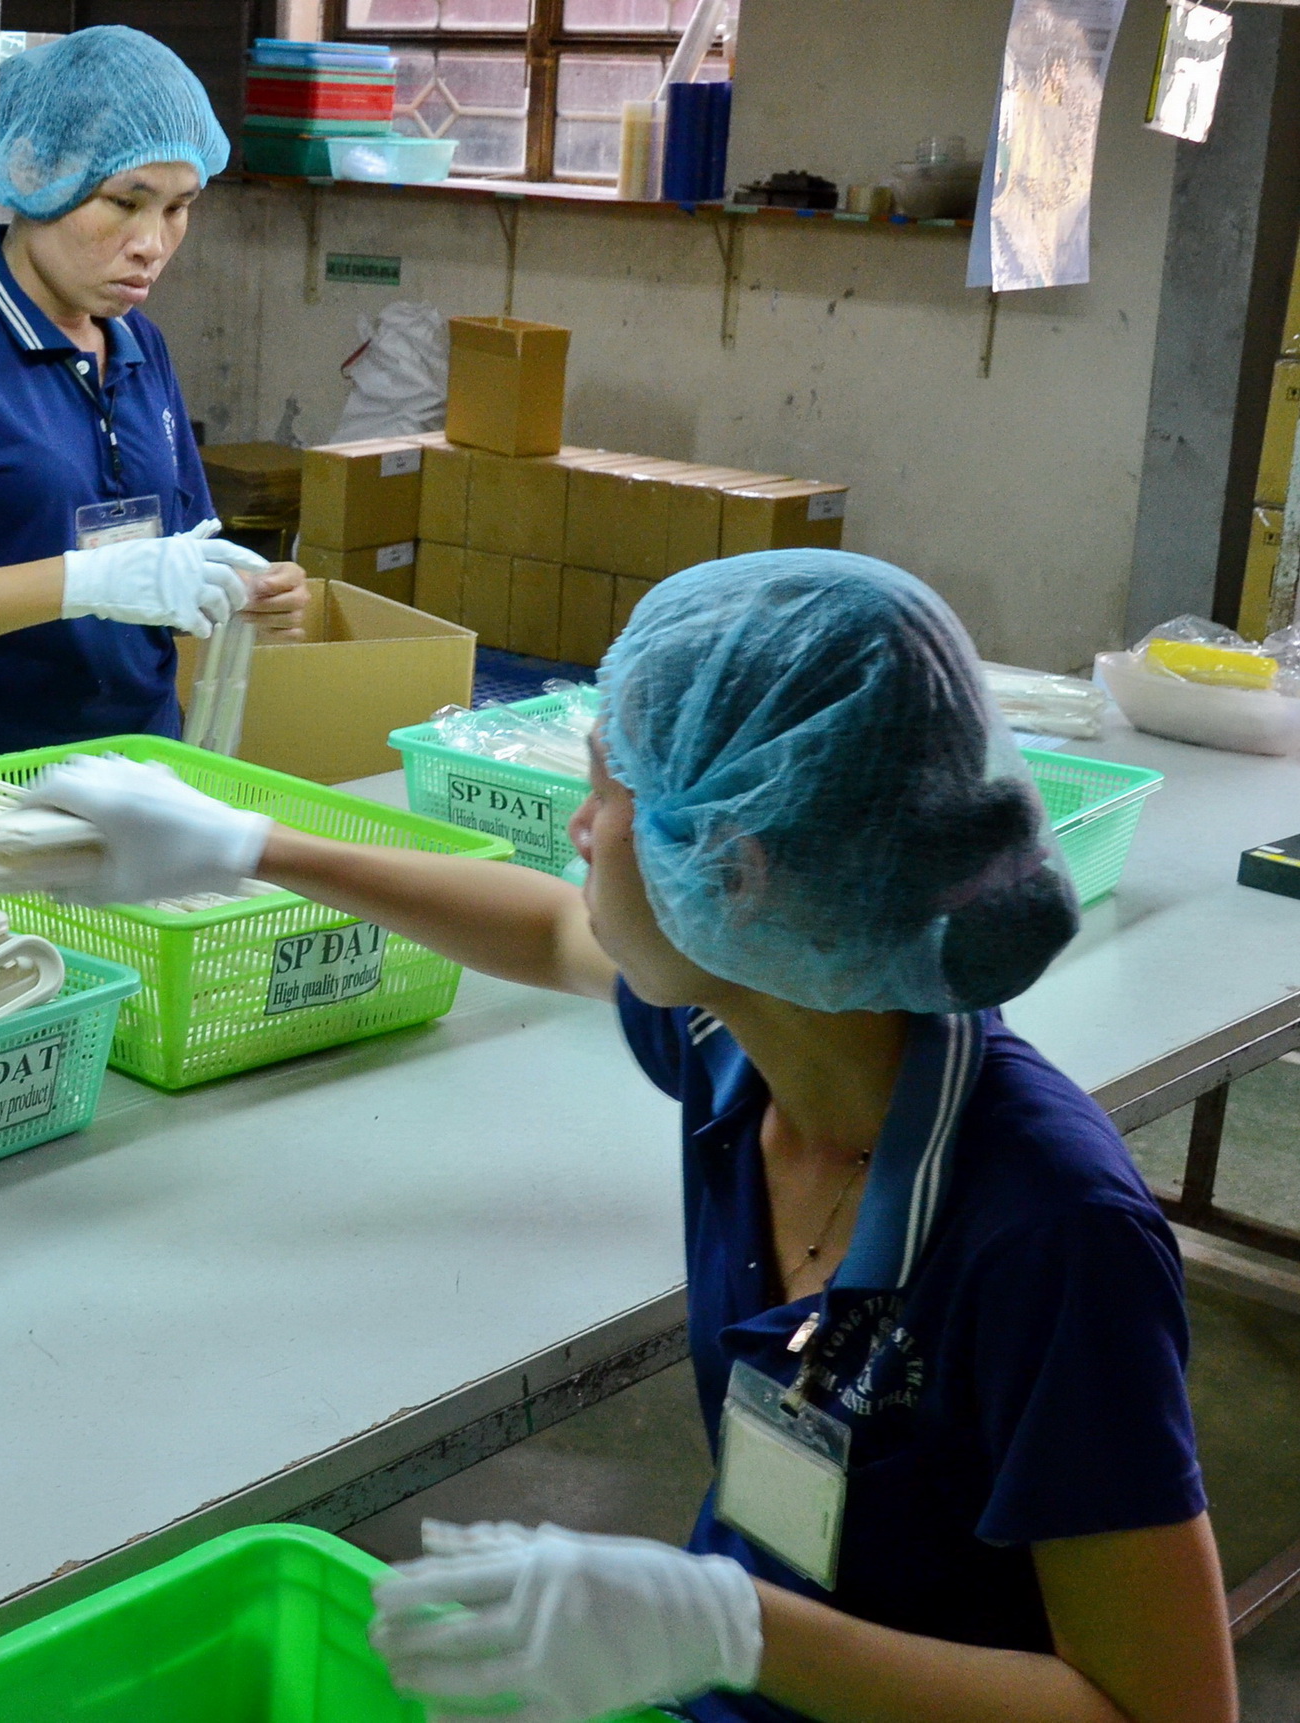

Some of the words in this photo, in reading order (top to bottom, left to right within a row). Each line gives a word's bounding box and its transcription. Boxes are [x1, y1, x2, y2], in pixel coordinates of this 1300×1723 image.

[451, 780, 482, 804] SP
[489, 789, 550, 821] ĐẠT
[275, 936, 314, 975] SP
[319, 923, 381, 966] ĐẠT
[302, 973, 339, 1004] quality
